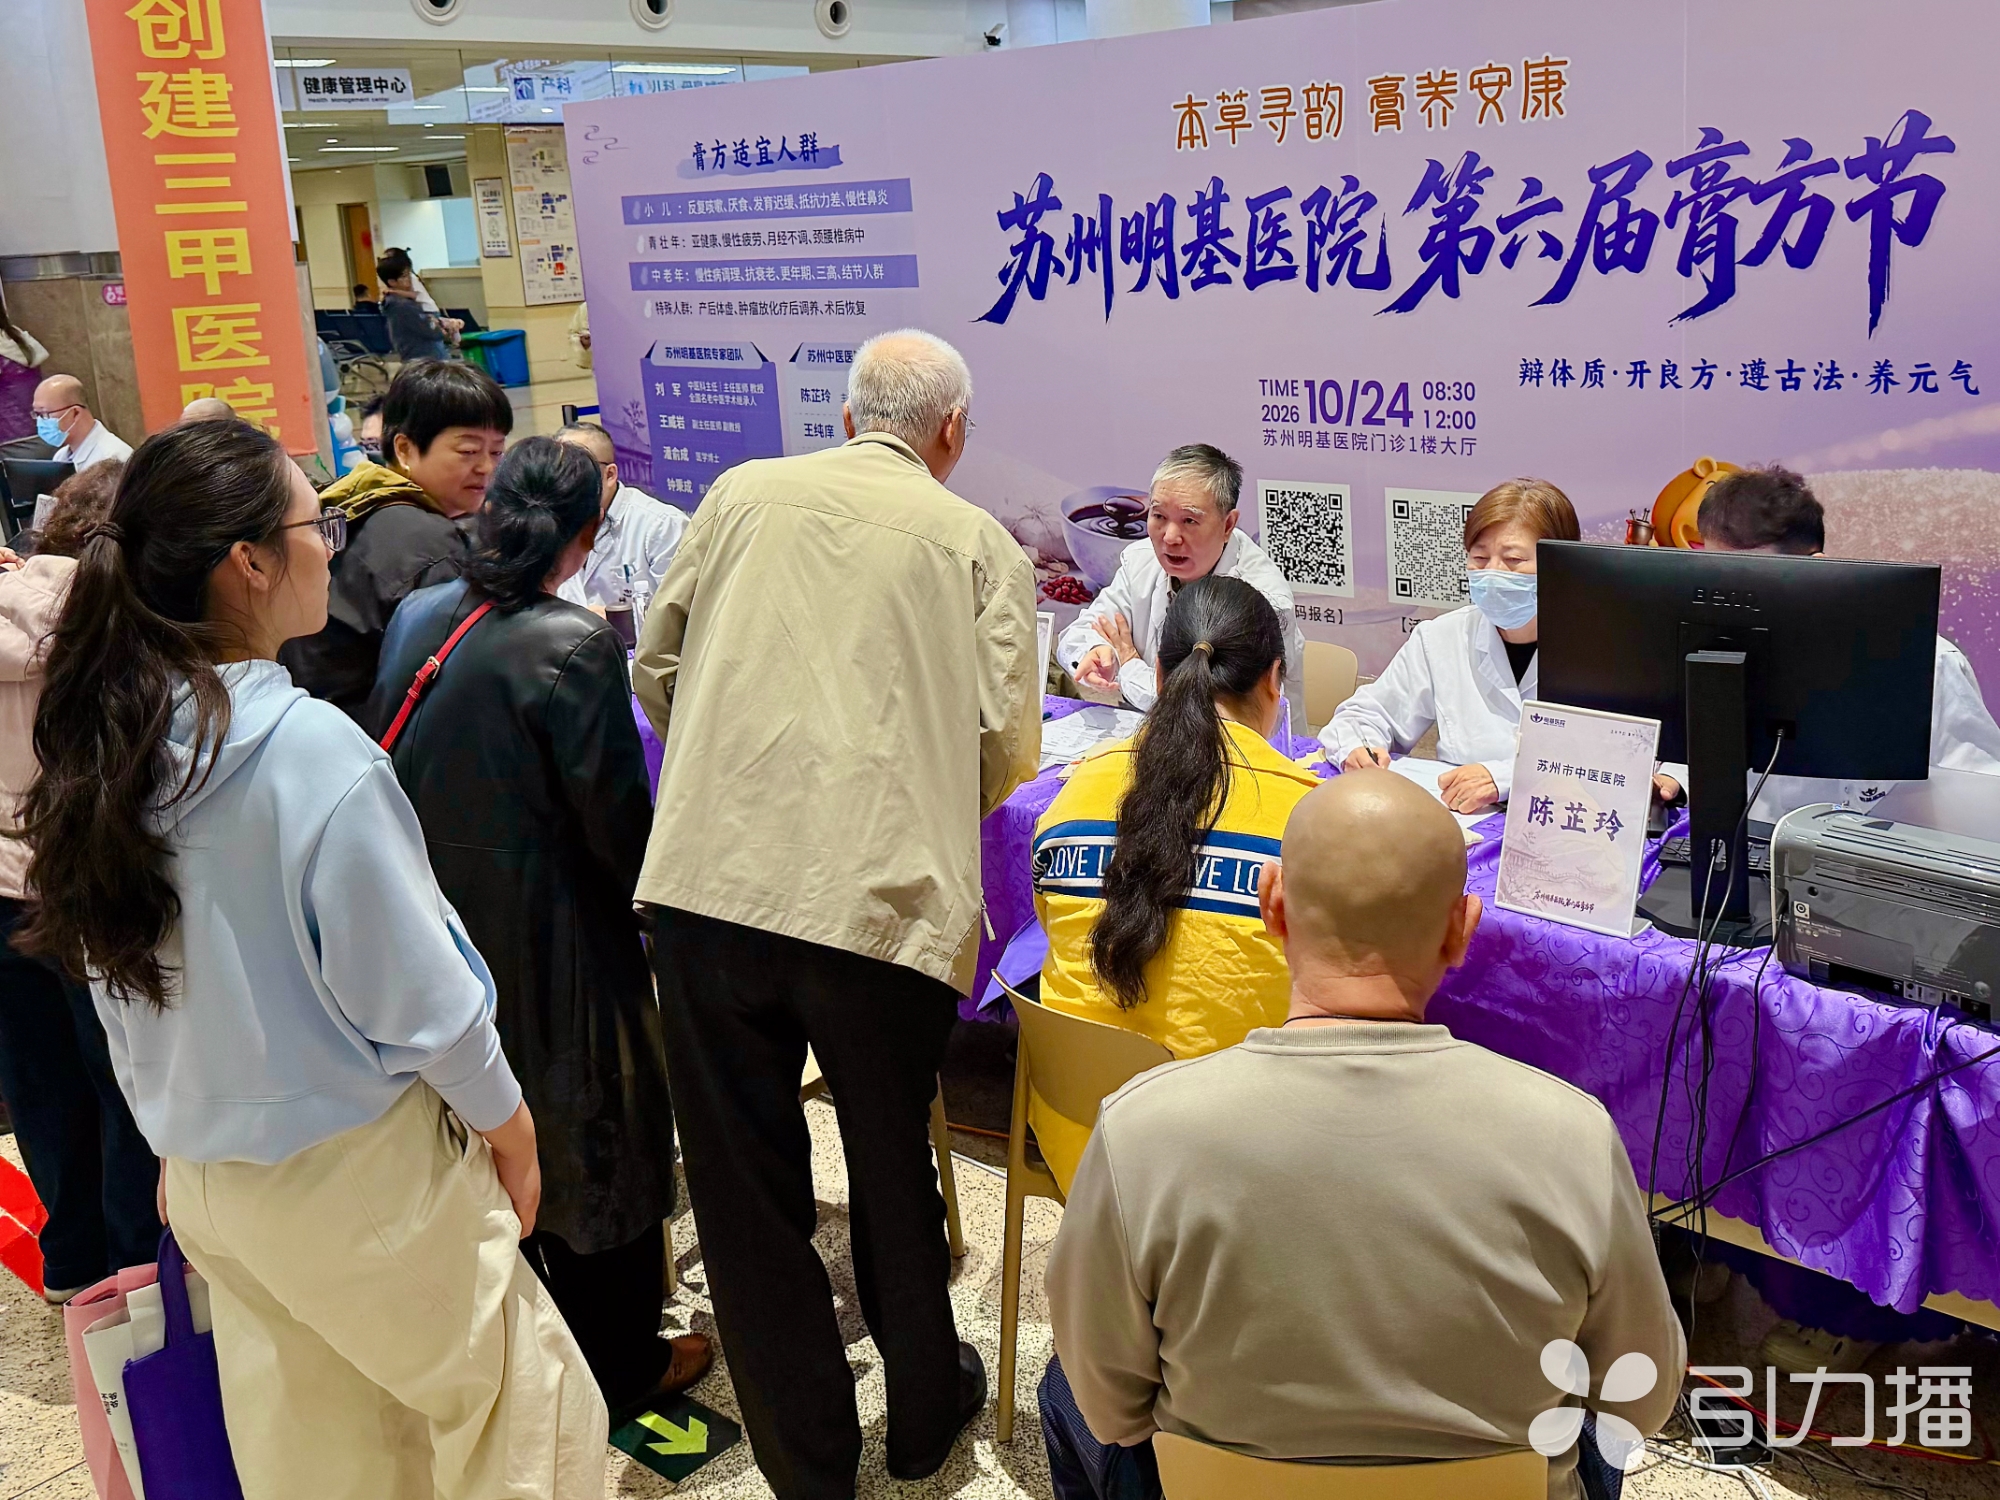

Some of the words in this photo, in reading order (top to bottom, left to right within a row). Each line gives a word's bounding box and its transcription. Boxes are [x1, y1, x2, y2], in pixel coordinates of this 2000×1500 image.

[303, 77, 406, 94] 健康管理中心
[1173, 83, 1343, 149] 本草寻韵
[1367, 56, 1568, 133] 膏养安康
[692, 131, 820, 172] 膏方适宜人群
[665, 347, 744, 361] 苏州明基医院专家团队
[807, 349, 856, 363] 苏州中医医
[800, 388, 831, 403] 陈芷玲
[1259, 379, 1299, 397] TIME
[1422, 381, 1476, 402] 08:30
[1261, 404, 1300, 423] 2026
[1304, 379, 1413, 428] 10/24
[1423, 410, 1476, 430] 12:00
[1263, 429, 1477, 456] 苏州明基医院门诊1楼大厅
[1295, 605, 1343, 624] 码报名】
[1536, 759, 1626, 787] 苏州市中医医院
[1527, 794, 1625, 842] 陈芷玲
[1048, 846, 1089, 877] LOVE
[1195, 857, 1224, 890] VE
